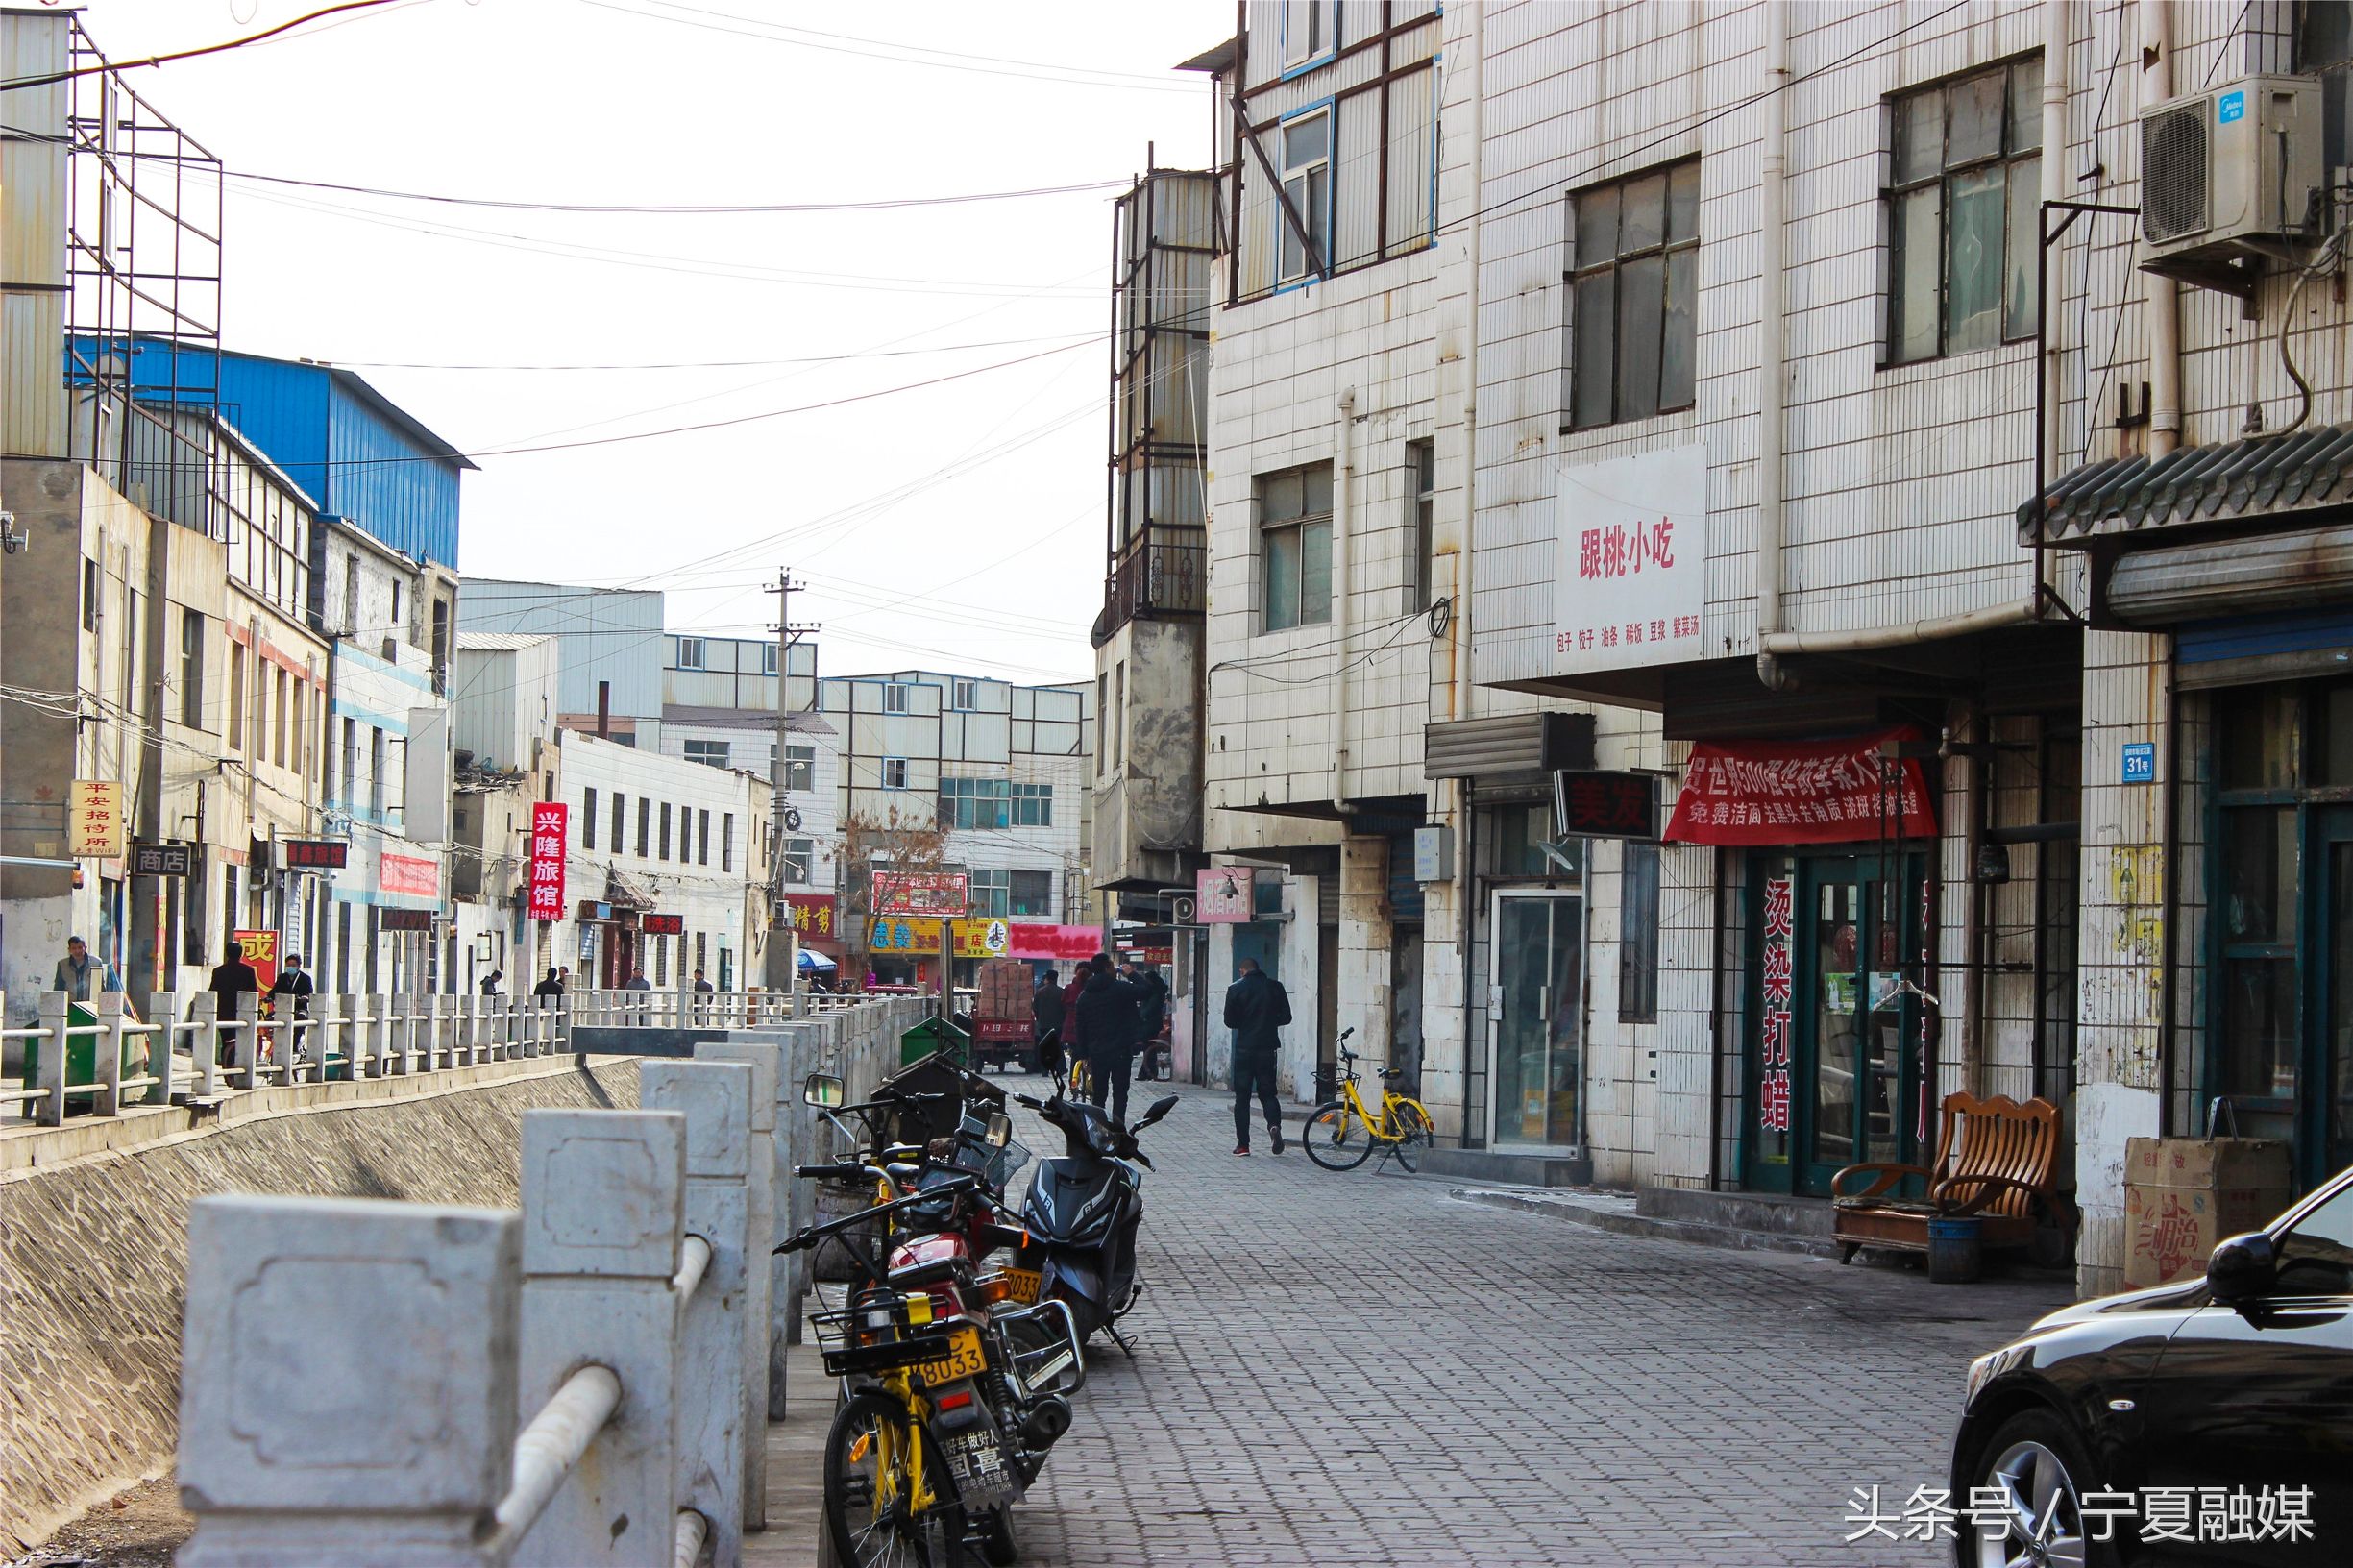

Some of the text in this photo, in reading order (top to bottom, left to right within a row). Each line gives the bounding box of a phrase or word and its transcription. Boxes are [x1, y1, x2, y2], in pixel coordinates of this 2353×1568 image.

[1580, 516, 1674, 580] 跟桃小吃
[1557, 615, 1700, 653] 包子 饺子 油条 稀饭 豆浆 紫菜汤
[2126, 757, 2149, 773] 31号
[84, 783, 110, 847] 平安招待所
[1572, 778, 1646, 828] 美发
[139, 849, 185, 872] 商店
[533, 811, 562, 907] 兴隆旅馆
[1761, 877, 1793, 1132] 烫染打蜡
